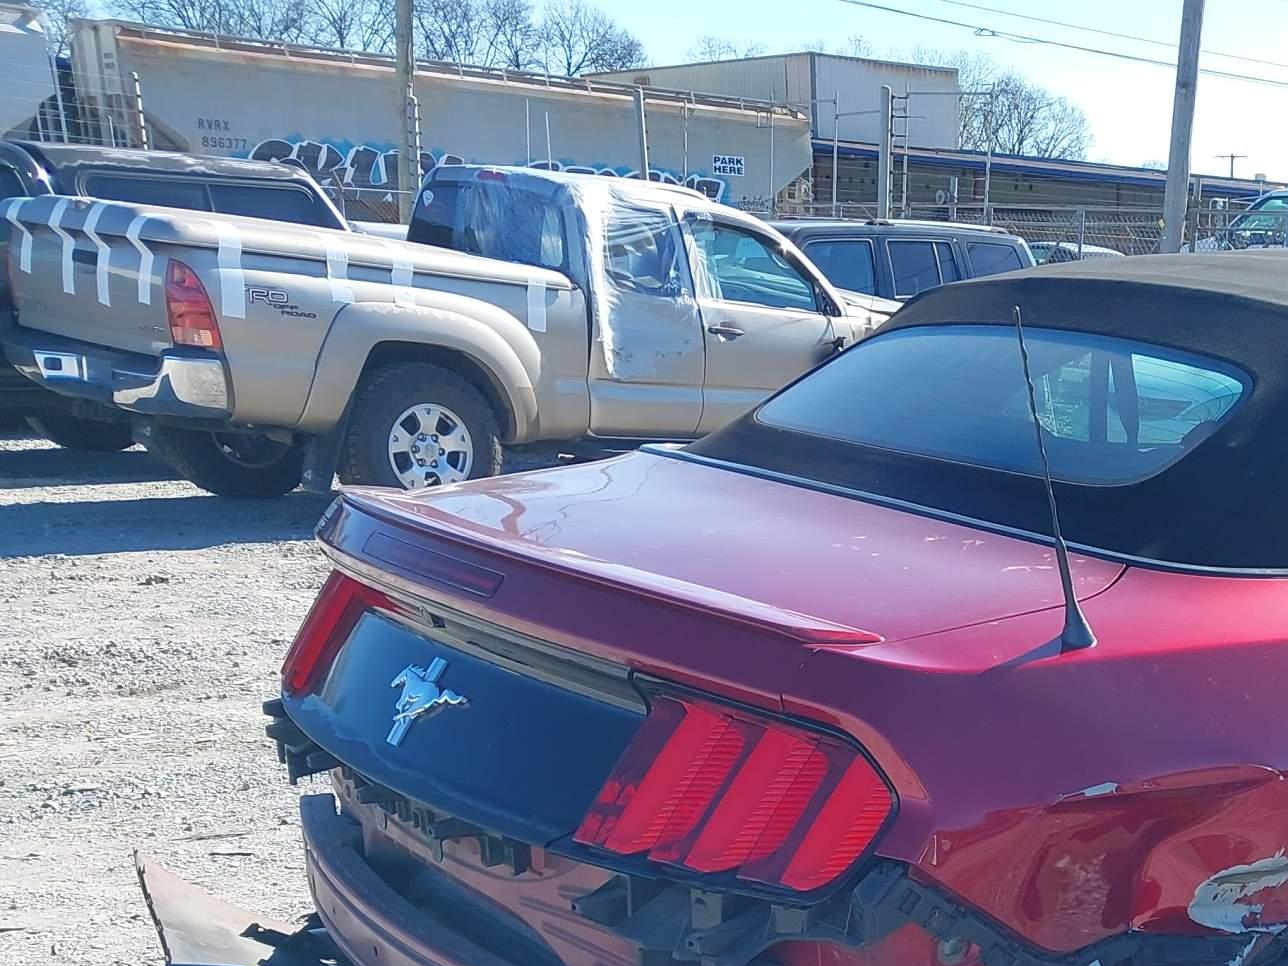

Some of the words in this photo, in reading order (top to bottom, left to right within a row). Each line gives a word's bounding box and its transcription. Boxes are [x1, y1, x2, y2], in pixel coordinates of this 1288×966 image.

[197, 118, 230, 131] RVRX
[202, 136, 247, 149] 896377
[713, 156, 743, 166] PARK
[713, 165, 743, 175] HERE
[273, 303, 299, 311] OFF
[281, 310, 317, 319] ROAD
